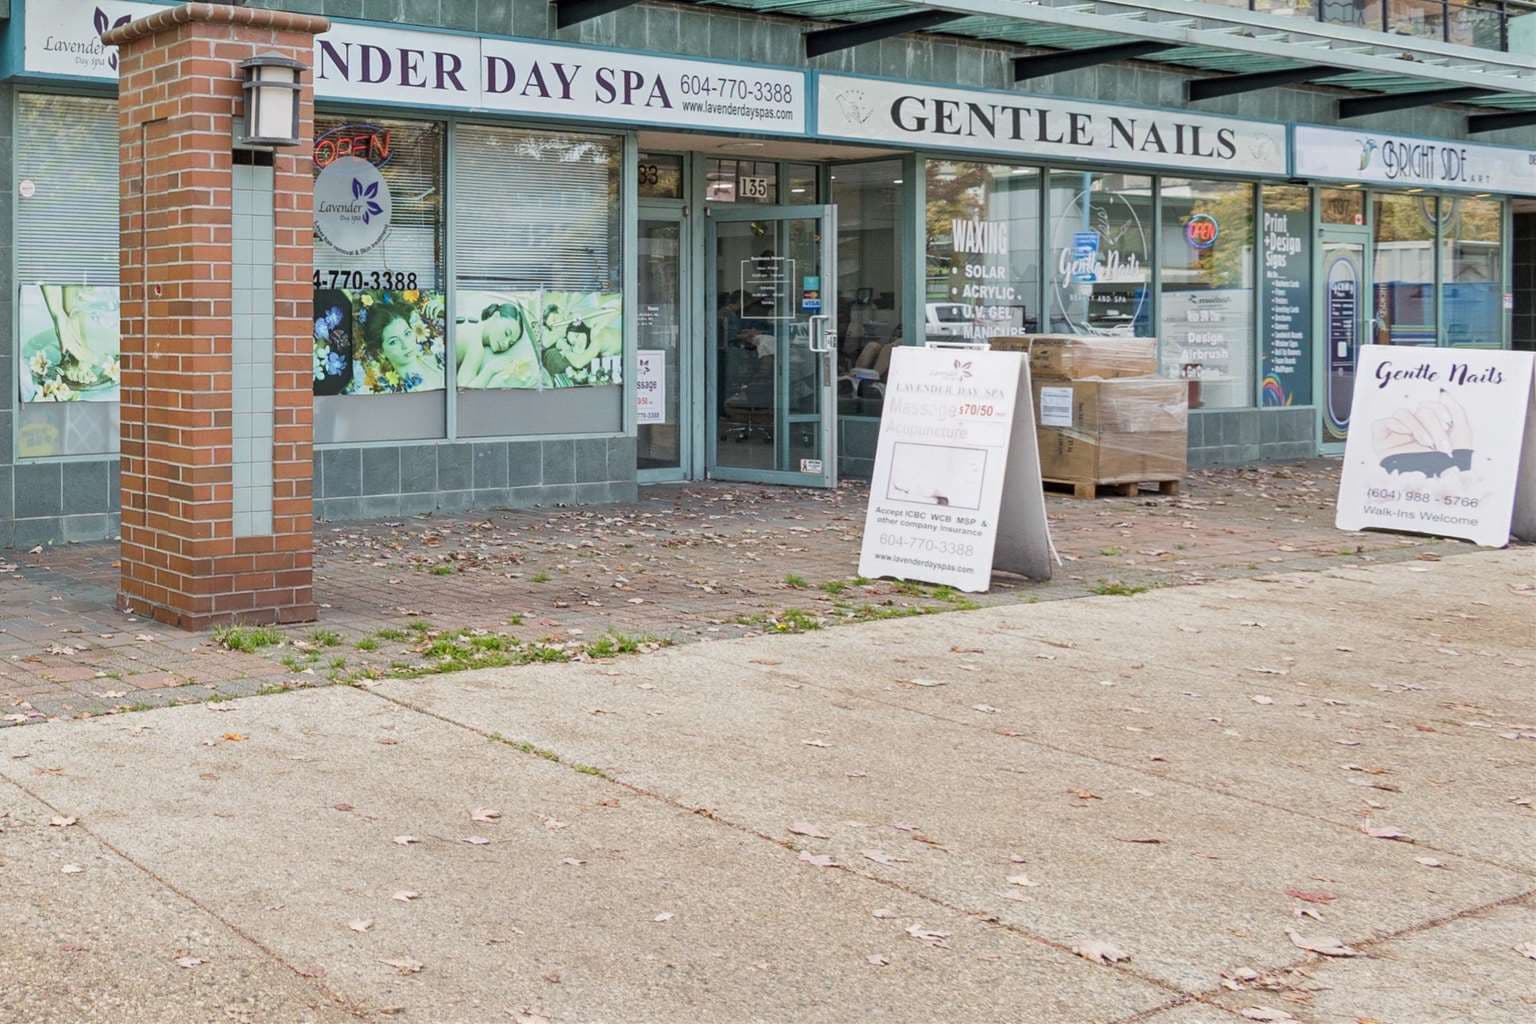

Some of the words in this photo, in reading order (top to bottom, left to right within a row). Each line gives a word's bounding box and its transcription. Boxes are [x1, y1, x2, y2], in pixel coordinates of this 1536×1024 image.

[43, 36, 106, 55] Lavender
[484, 55, 582, 100] DAY
[594, 67, 674, 109] SPA
[680, 74, 793, 104] 604-770-3388
[682, 100, 794, 120] www.lavenderdayspas.com
[889, 95, 1095, 147] GENTLE
[1109, 116, 1237, 160] NAILS
[313, 130, 392, 169] OPEN
[1382, 140, 1436, 179] BRIGHT
[1440, 147, 1467, 183] SIDE
[741, 177, 767, 197] 135
[1469, 176, 1491, 184] ART
[319, 200, 363, 214] Lavender
[1190, 221, 1216, 240] OPEN
[1264, 213, 1288, 232] Print
[952, 218, 1009, 255] WAXING
[1060, 247, 1102, 288] Gentle
[1103, 249, 1139, 276] Nails
[1266, 250, 1287, 269] Signs
[965, 265, 1006, 279] SOLAR
[1113, 296, 1127, 304] SPA
[988, 306, 1013, 320] GEL
[1187, 333, 1224, 346] Design
[1181, 349, 1229, 361] Airbrush
[1375, 360, 1439, 389] Gentle
[1448, 363, 1505, 386] Nails
[896, 383, 954, 394] LAVENDER
[959, 404, 994, 417] $70/50
[885, 418, 969, 440] Acupuncture
[1366, 487, 1401, 500] (604)
[1404, 490, 1431, 503] 988
[1443, 495, 1480, 509] 5766
[875, 507, 906, 518] Accept
[905, 508, 926, 519] ICBC
[930, 513, 952, 523] WCB
[956, 516, 977, 526] MSP
[980, 520, 988, 528] &
[1362, 504, 1416, 519] Walk-Ins
[1419, 511, 1480, 527] Welcome
[877, 516, 898, 525] other
[899, 520, 937, 532] company
[939, 525, 984, 536] insurance
[879, 533, 974, 557] 604-770-3388
[874, 553, 975, 574] www.lavenderdayspas.com
